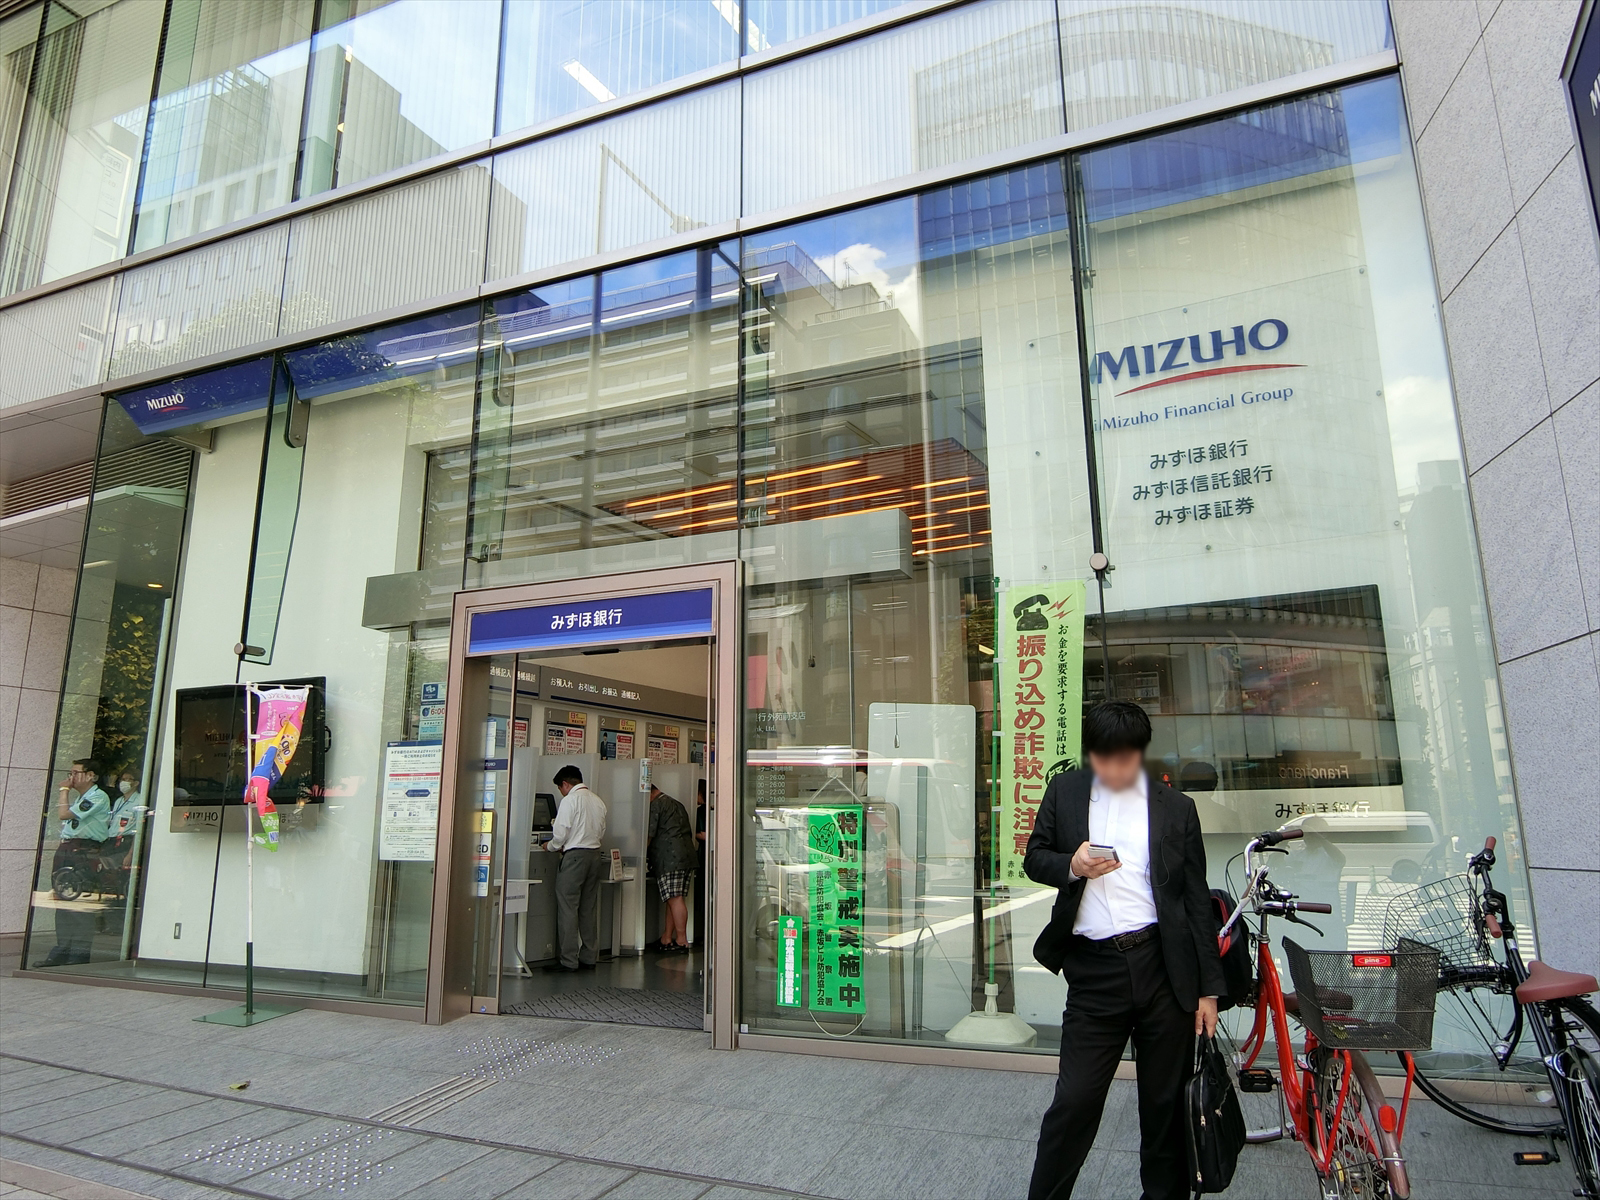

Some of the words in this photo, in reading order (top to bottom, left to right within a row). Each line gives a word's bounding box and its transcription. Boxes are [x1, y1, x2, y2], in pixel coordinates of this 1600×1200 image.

[1089, 318, 1289, 384] MIZUHO
[146, 393, 184, 411] MIZUHO
[1102, 408, 1159, 431] Mizuho
[1164, 394, 1235, 420] Financial
[1241, 387, 1294, 405] Group
[1149, 438, 1249, 470] みずほ銀行
[1132, 464, 1274, 501] みずほ信託銀行
[1154, 497, 1255, 526] みずほ証券
[550, 608, 623, 630] みずほ銀行
[578, 682, 599, 694] お引出し
[1056, 624, 1069, 756] お金を要求する電話は
[601, 718, 605, 726] 2
[837, 811, 861, 1008] 特別警戒実施中
[1364, 956, 1380, 964] pine
